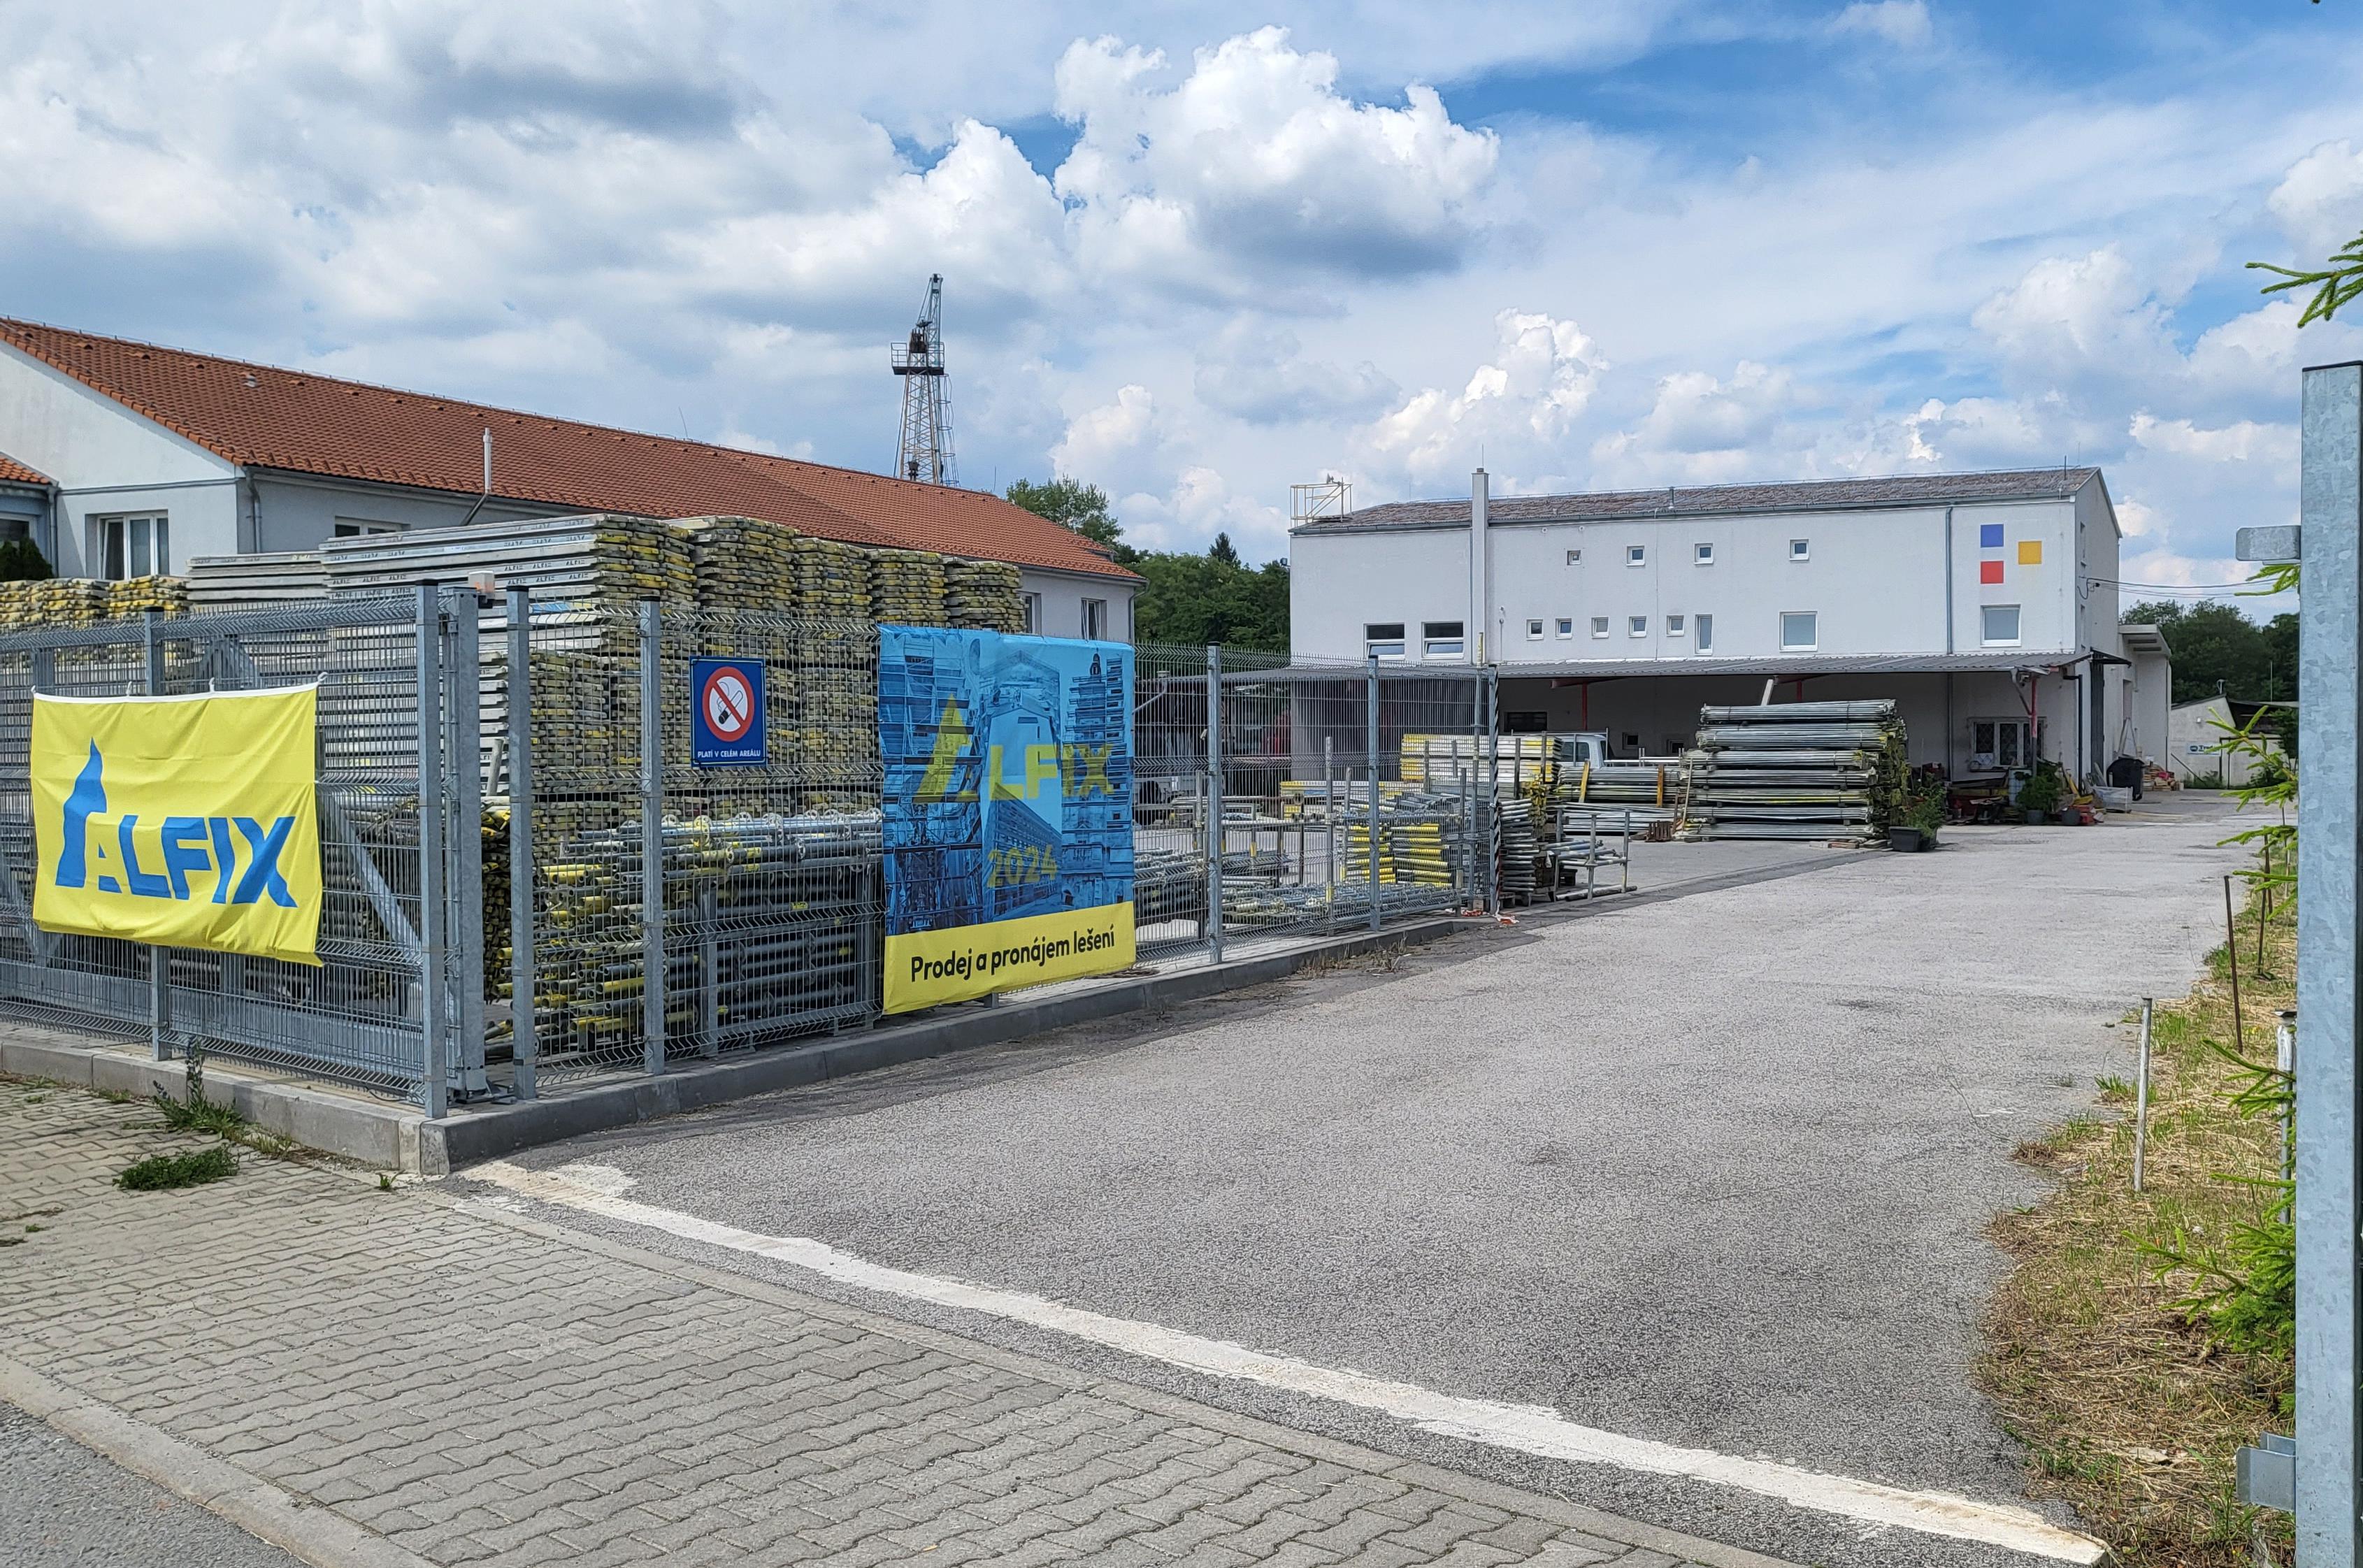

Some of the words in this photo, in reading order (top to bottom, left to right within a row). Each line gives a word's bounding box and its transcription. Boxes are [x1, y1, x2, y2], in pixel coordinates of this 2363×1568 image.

[697, 749, 713, 758] PLATÍ
[720, 749, 738, 758] CELÉM
[739, 748, 761, 757] AREÁLU
[912, 693, 1115, 805] ALFIX
[55, 736, 299, 908] ALFIX
[986, 844, 1058, 889] 2024
[911, 947, 972, 982] Prodej
[976, 952, 988, 971] a
[991, 935, 1070, 976] pronájem
[1073, 923, 1115, 955] lešení
